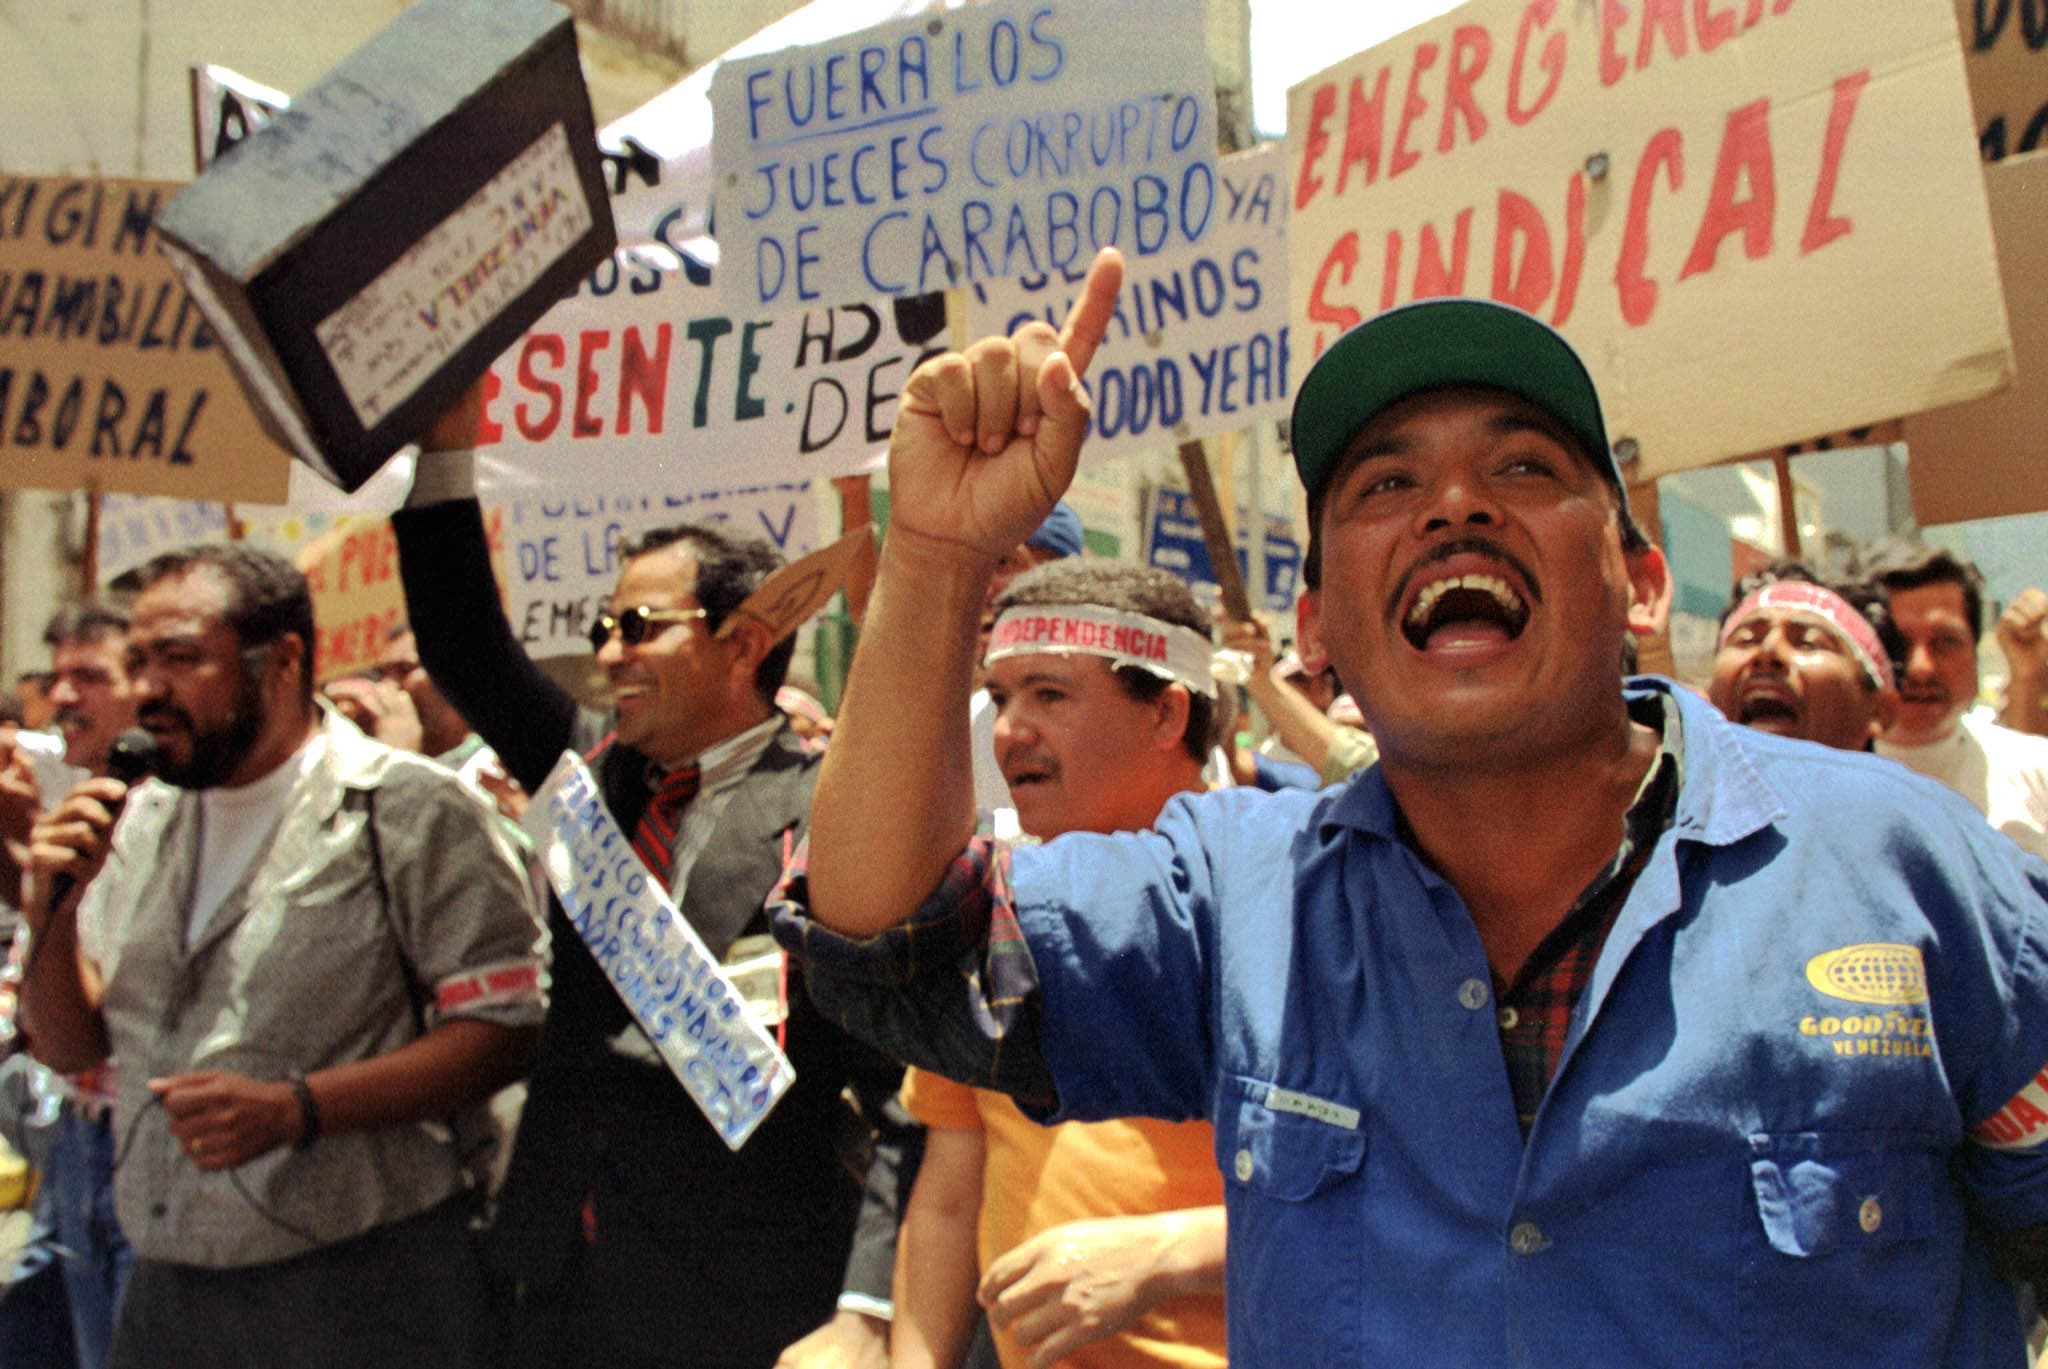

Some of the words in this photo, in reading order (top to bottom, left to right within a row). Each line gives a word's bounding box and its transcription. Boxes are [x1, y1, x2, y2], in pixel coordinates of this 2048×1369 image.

[747, 36, 929, 139] FUERA
[954, 9, 1063, 94] LOS
[1294, 0, 1794, 209] EMERGEN
[745, 126, 948, 220] JUECES
[970, 96, 1199, 188] CORRUPTO
[758, 226, 821, 303] DE
[862, 161, 1214, 294] CARABOBO
[518, 538, 560, 582] DE
